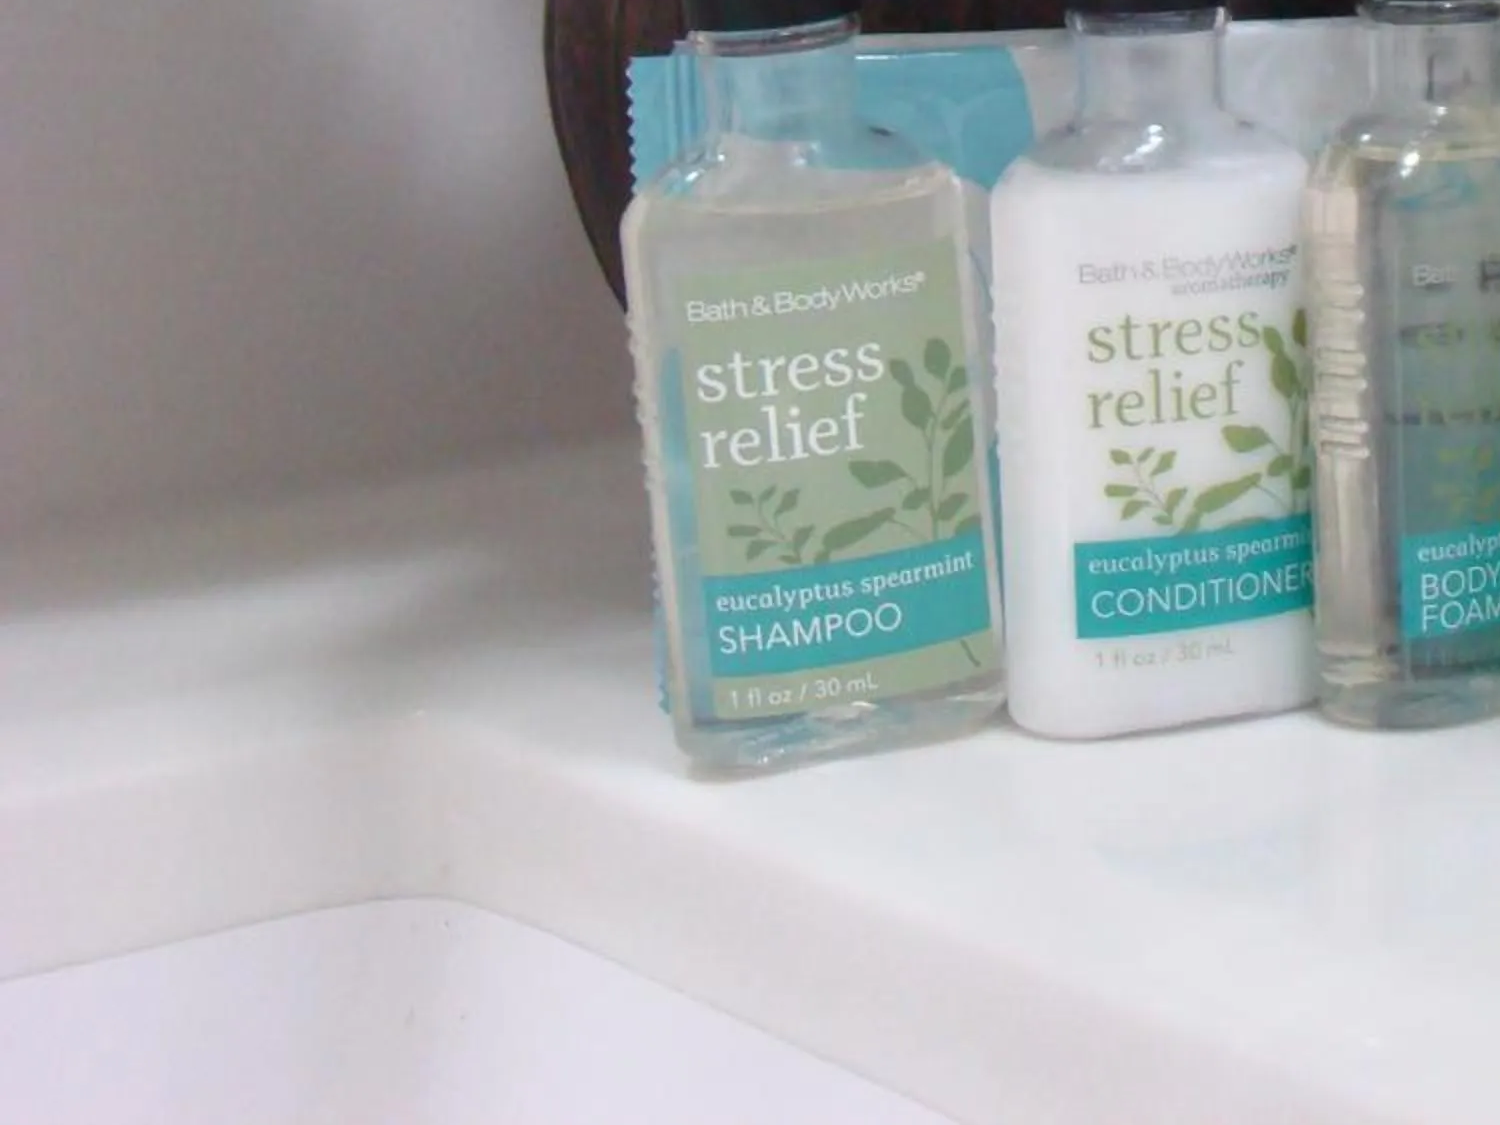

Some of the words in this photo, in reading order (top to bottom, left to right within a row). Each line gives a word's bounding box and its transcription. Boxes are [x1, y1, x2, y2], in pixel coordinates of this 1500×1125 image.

[1078, 263, 1137, 284] Bath
[686, 298, 748, 322] Bath
[752, 295, 771, 316] &
[1088, 309, 1260, 363] stress
[696, 342, 884, 403] stress
[1087, 360, 1244, 430] relief
[701, 394, 867, 468] relief
[1089, 548, 1219, 575] eucalyptus
[1226, 530, 1302, 563] spearm
[716, 580, 854, 612] eucalyptus
[860, 551, 974, 596] spearmint
[1091, 561, 1313, 618] CONDITIONER
[719, 603, 902, 654] SHAMPOO
[748, 687, 762, 709] fl
[768, 689, 791, 706] oz
[816, 678, 841, 699] 30
[847, 673, 879, 692] mL
